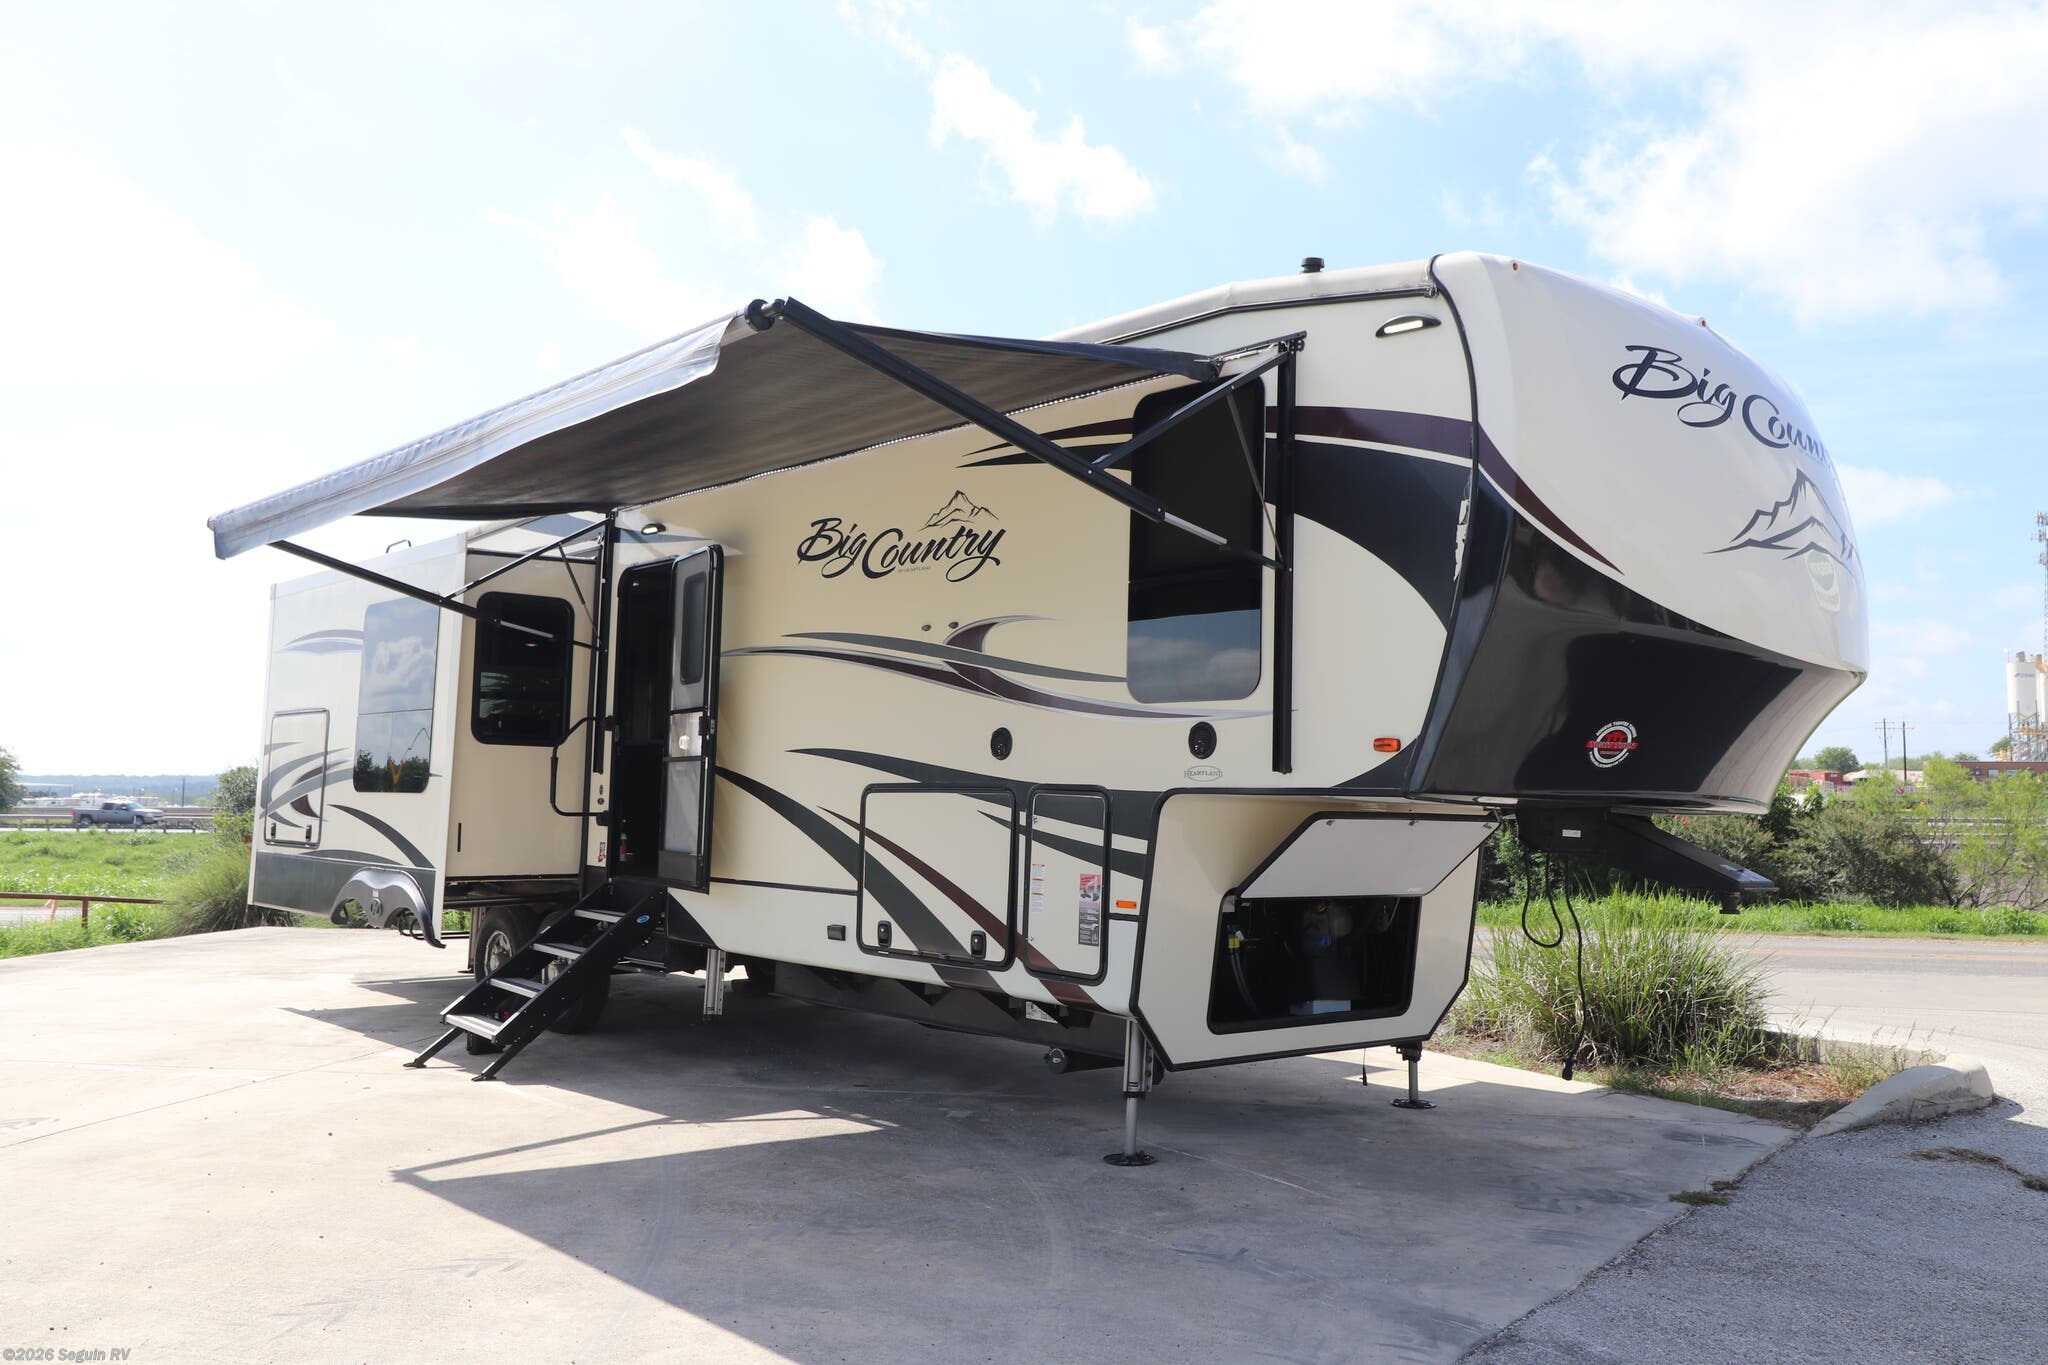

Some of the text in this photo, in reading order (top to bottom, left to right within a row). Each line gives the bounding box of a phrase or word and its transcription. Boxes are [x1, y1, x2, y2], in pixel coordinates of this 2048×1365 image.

[1612, 345, 1737, 428] Big
[797, 517, 1006, 582] Big Country
